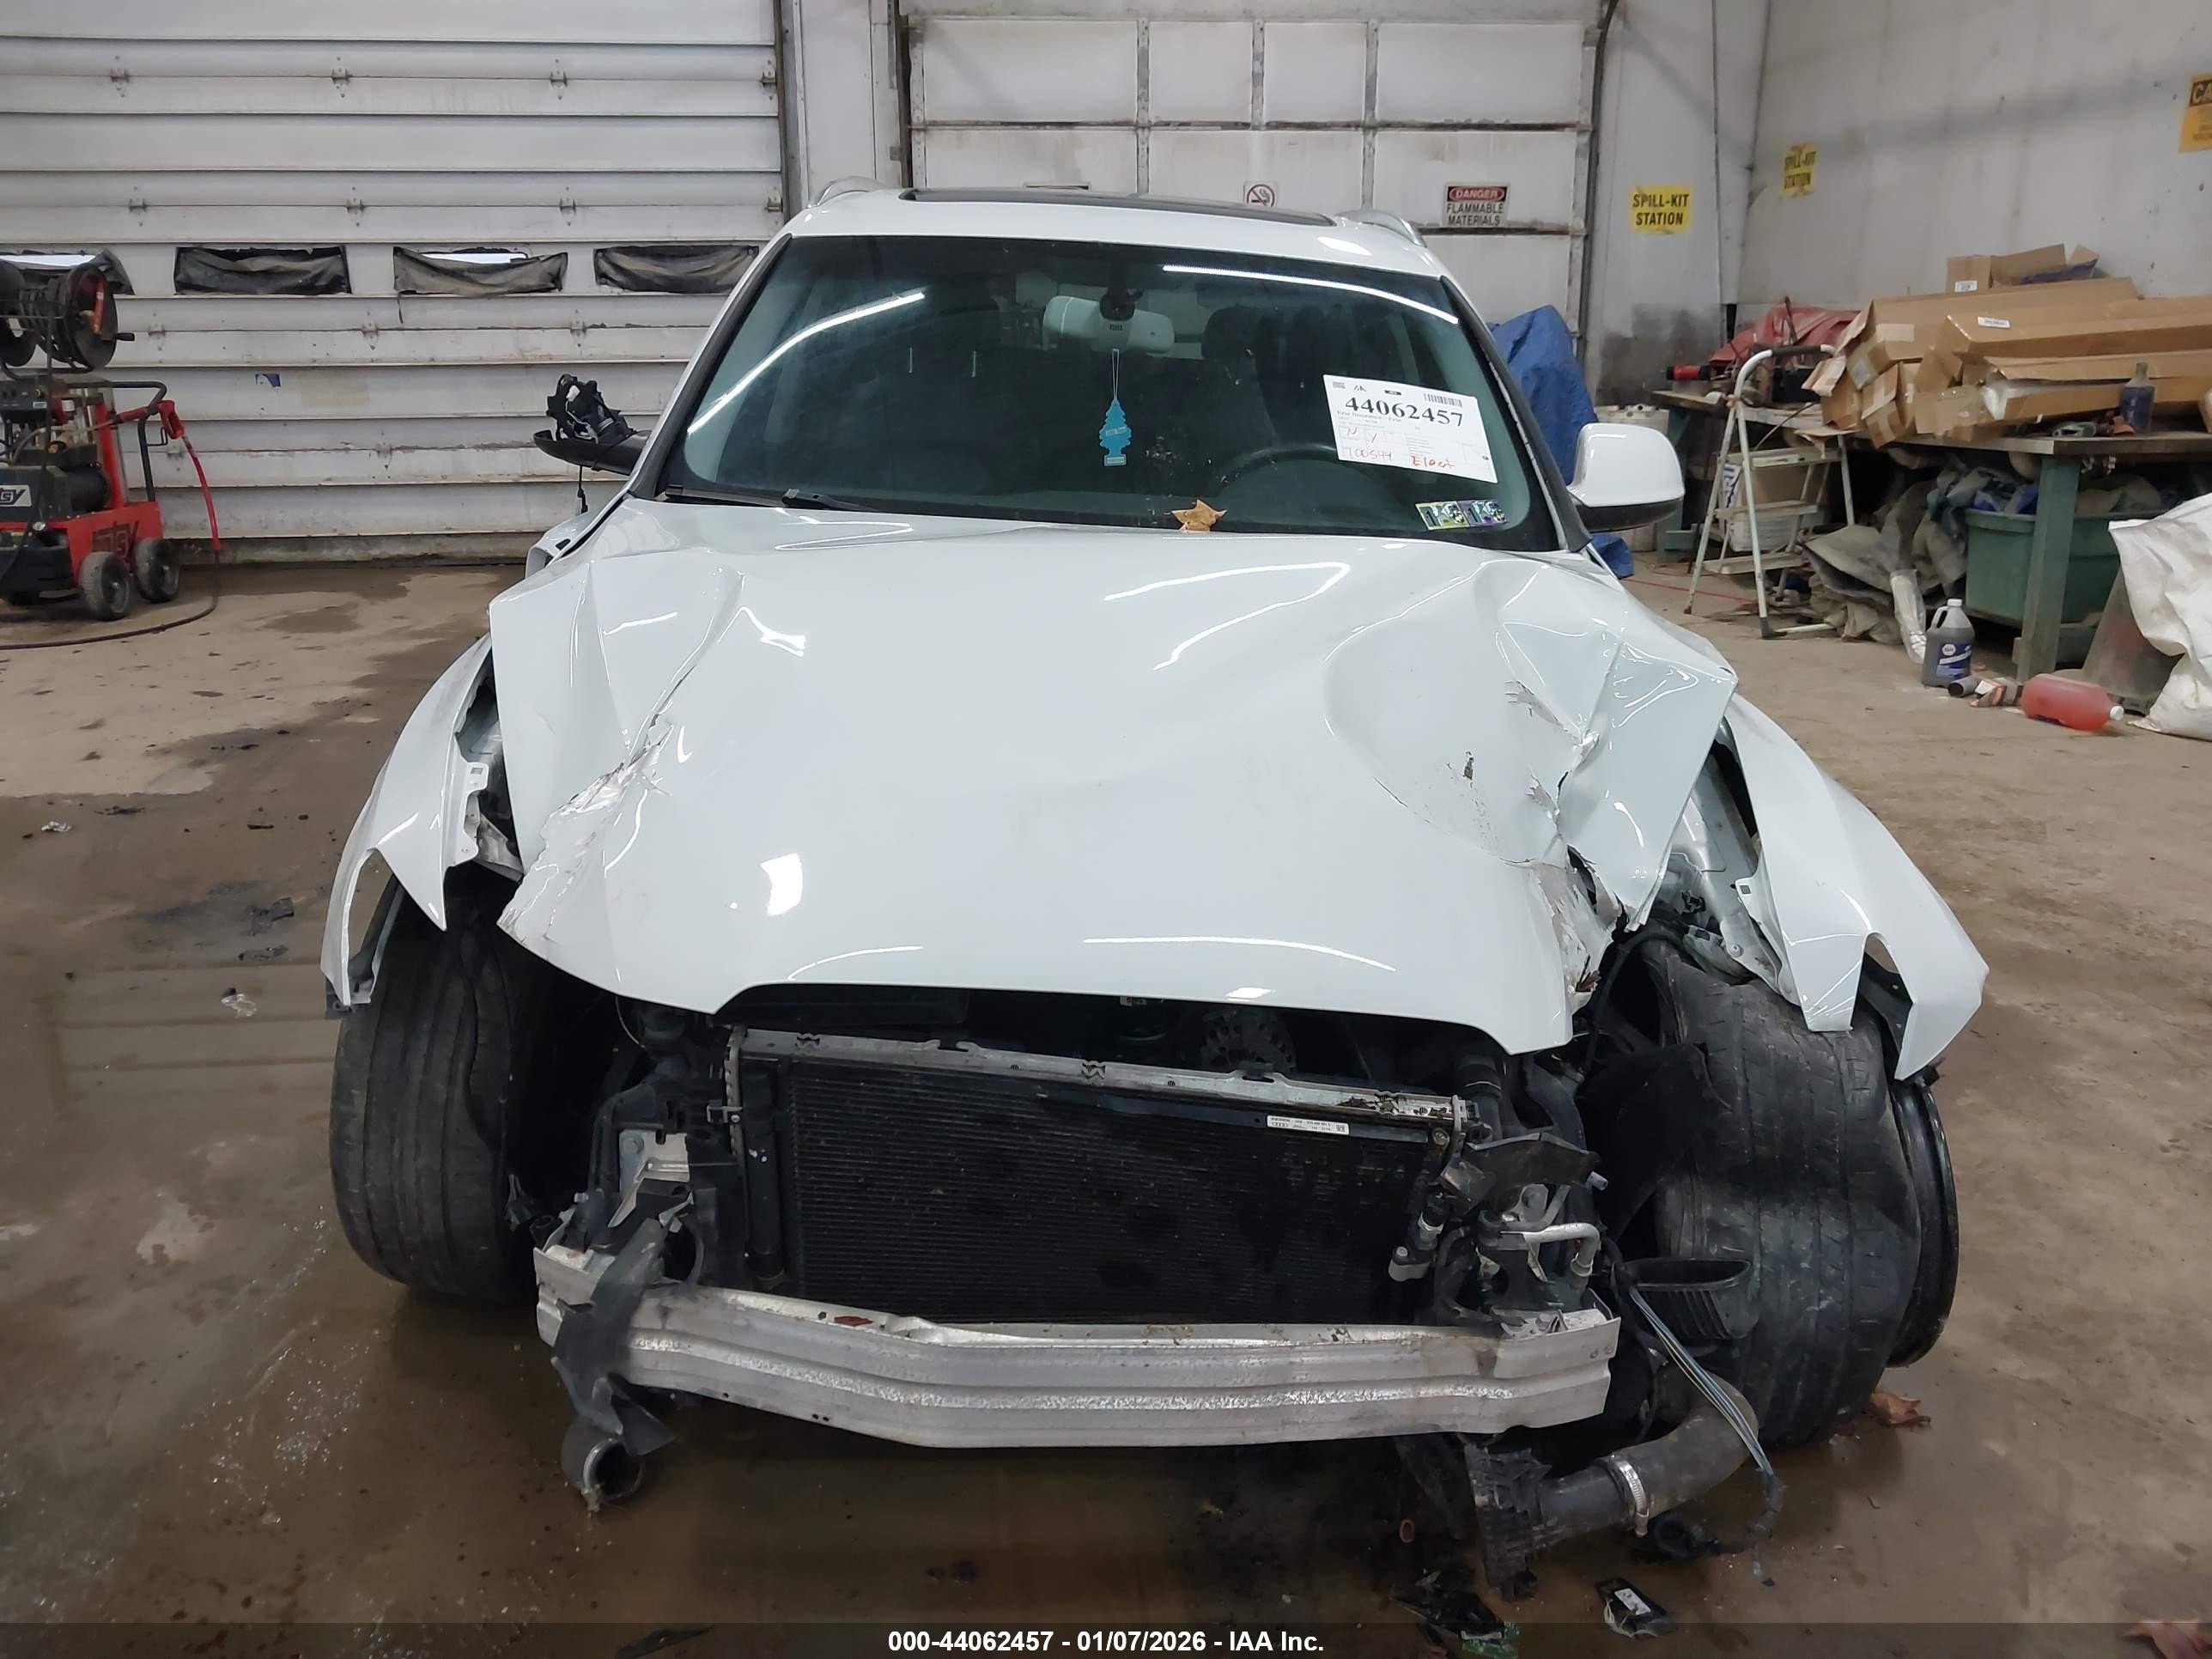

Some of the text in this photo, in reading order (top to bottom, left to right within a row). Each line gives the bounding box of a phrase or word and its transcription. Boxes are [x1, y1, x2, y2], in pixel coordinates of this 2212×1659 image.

[1455, 189, 1498, 199] DANGER
[1633, 193, 1690, 208] SPILL-KIT
[1447, 203, 1504, 214] FLAMMABLE
[1448, 216, 1500, 226] MATERIALS
[1636, 211, 1683, 226] STATION
[1345, 397, 1463, 427] 44062457
